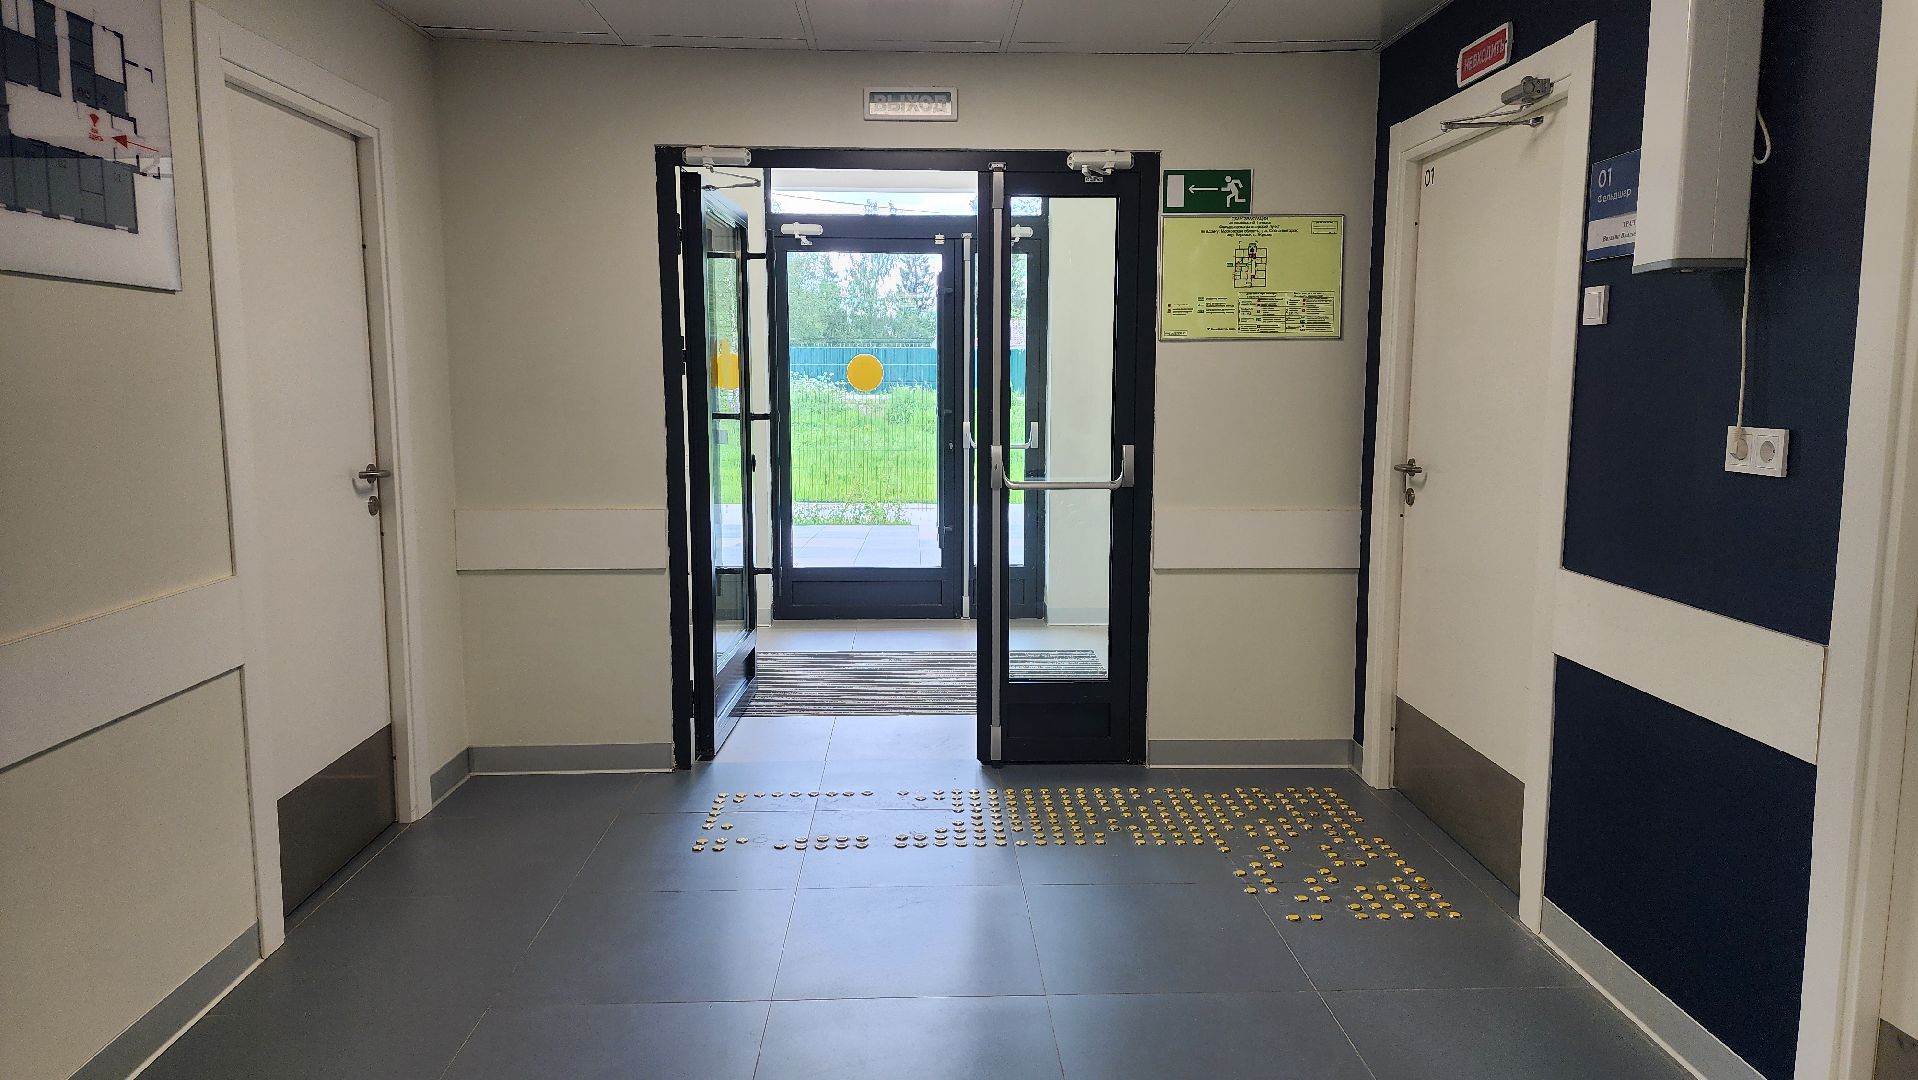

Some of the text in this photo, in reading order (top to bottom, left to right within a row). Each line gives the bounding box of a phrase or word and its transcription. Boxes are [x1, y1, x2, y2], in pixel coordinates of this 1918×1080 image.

[873, 94, 947, 113] ВЫХОД
[1425, 167, 1435, 187] 01
[1598, 167, 1613, 188] 01
